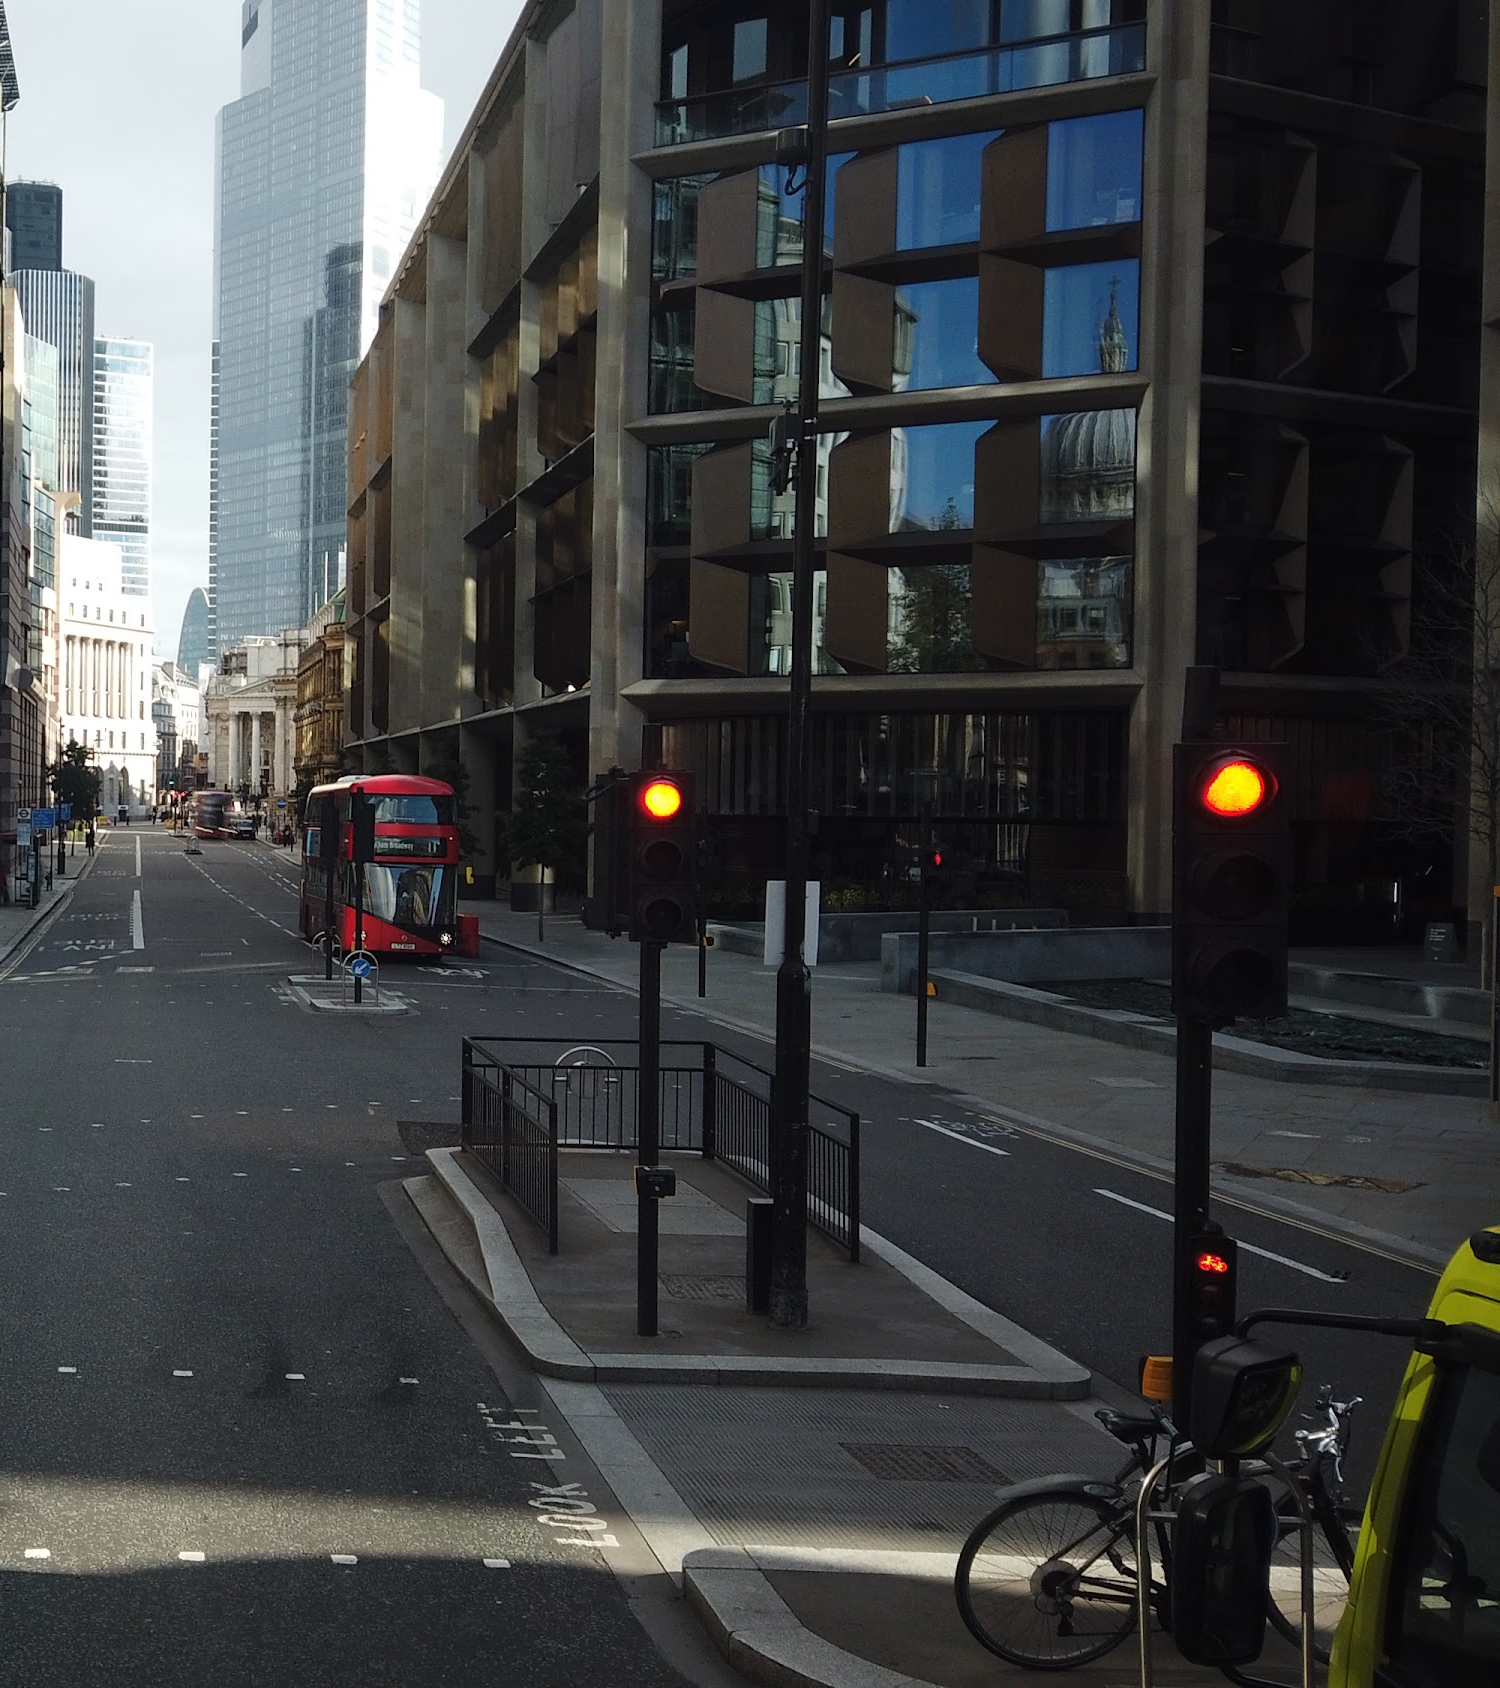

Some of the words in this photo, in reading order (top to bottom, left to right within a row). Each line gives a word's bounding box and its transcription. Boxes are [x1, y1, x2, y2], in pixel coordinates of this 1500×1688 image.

[389, 841, 414, 851] Broadway
[476, 1402, 566, 1460] LEFT
[527, 1481, 620, 1549] LOOK
